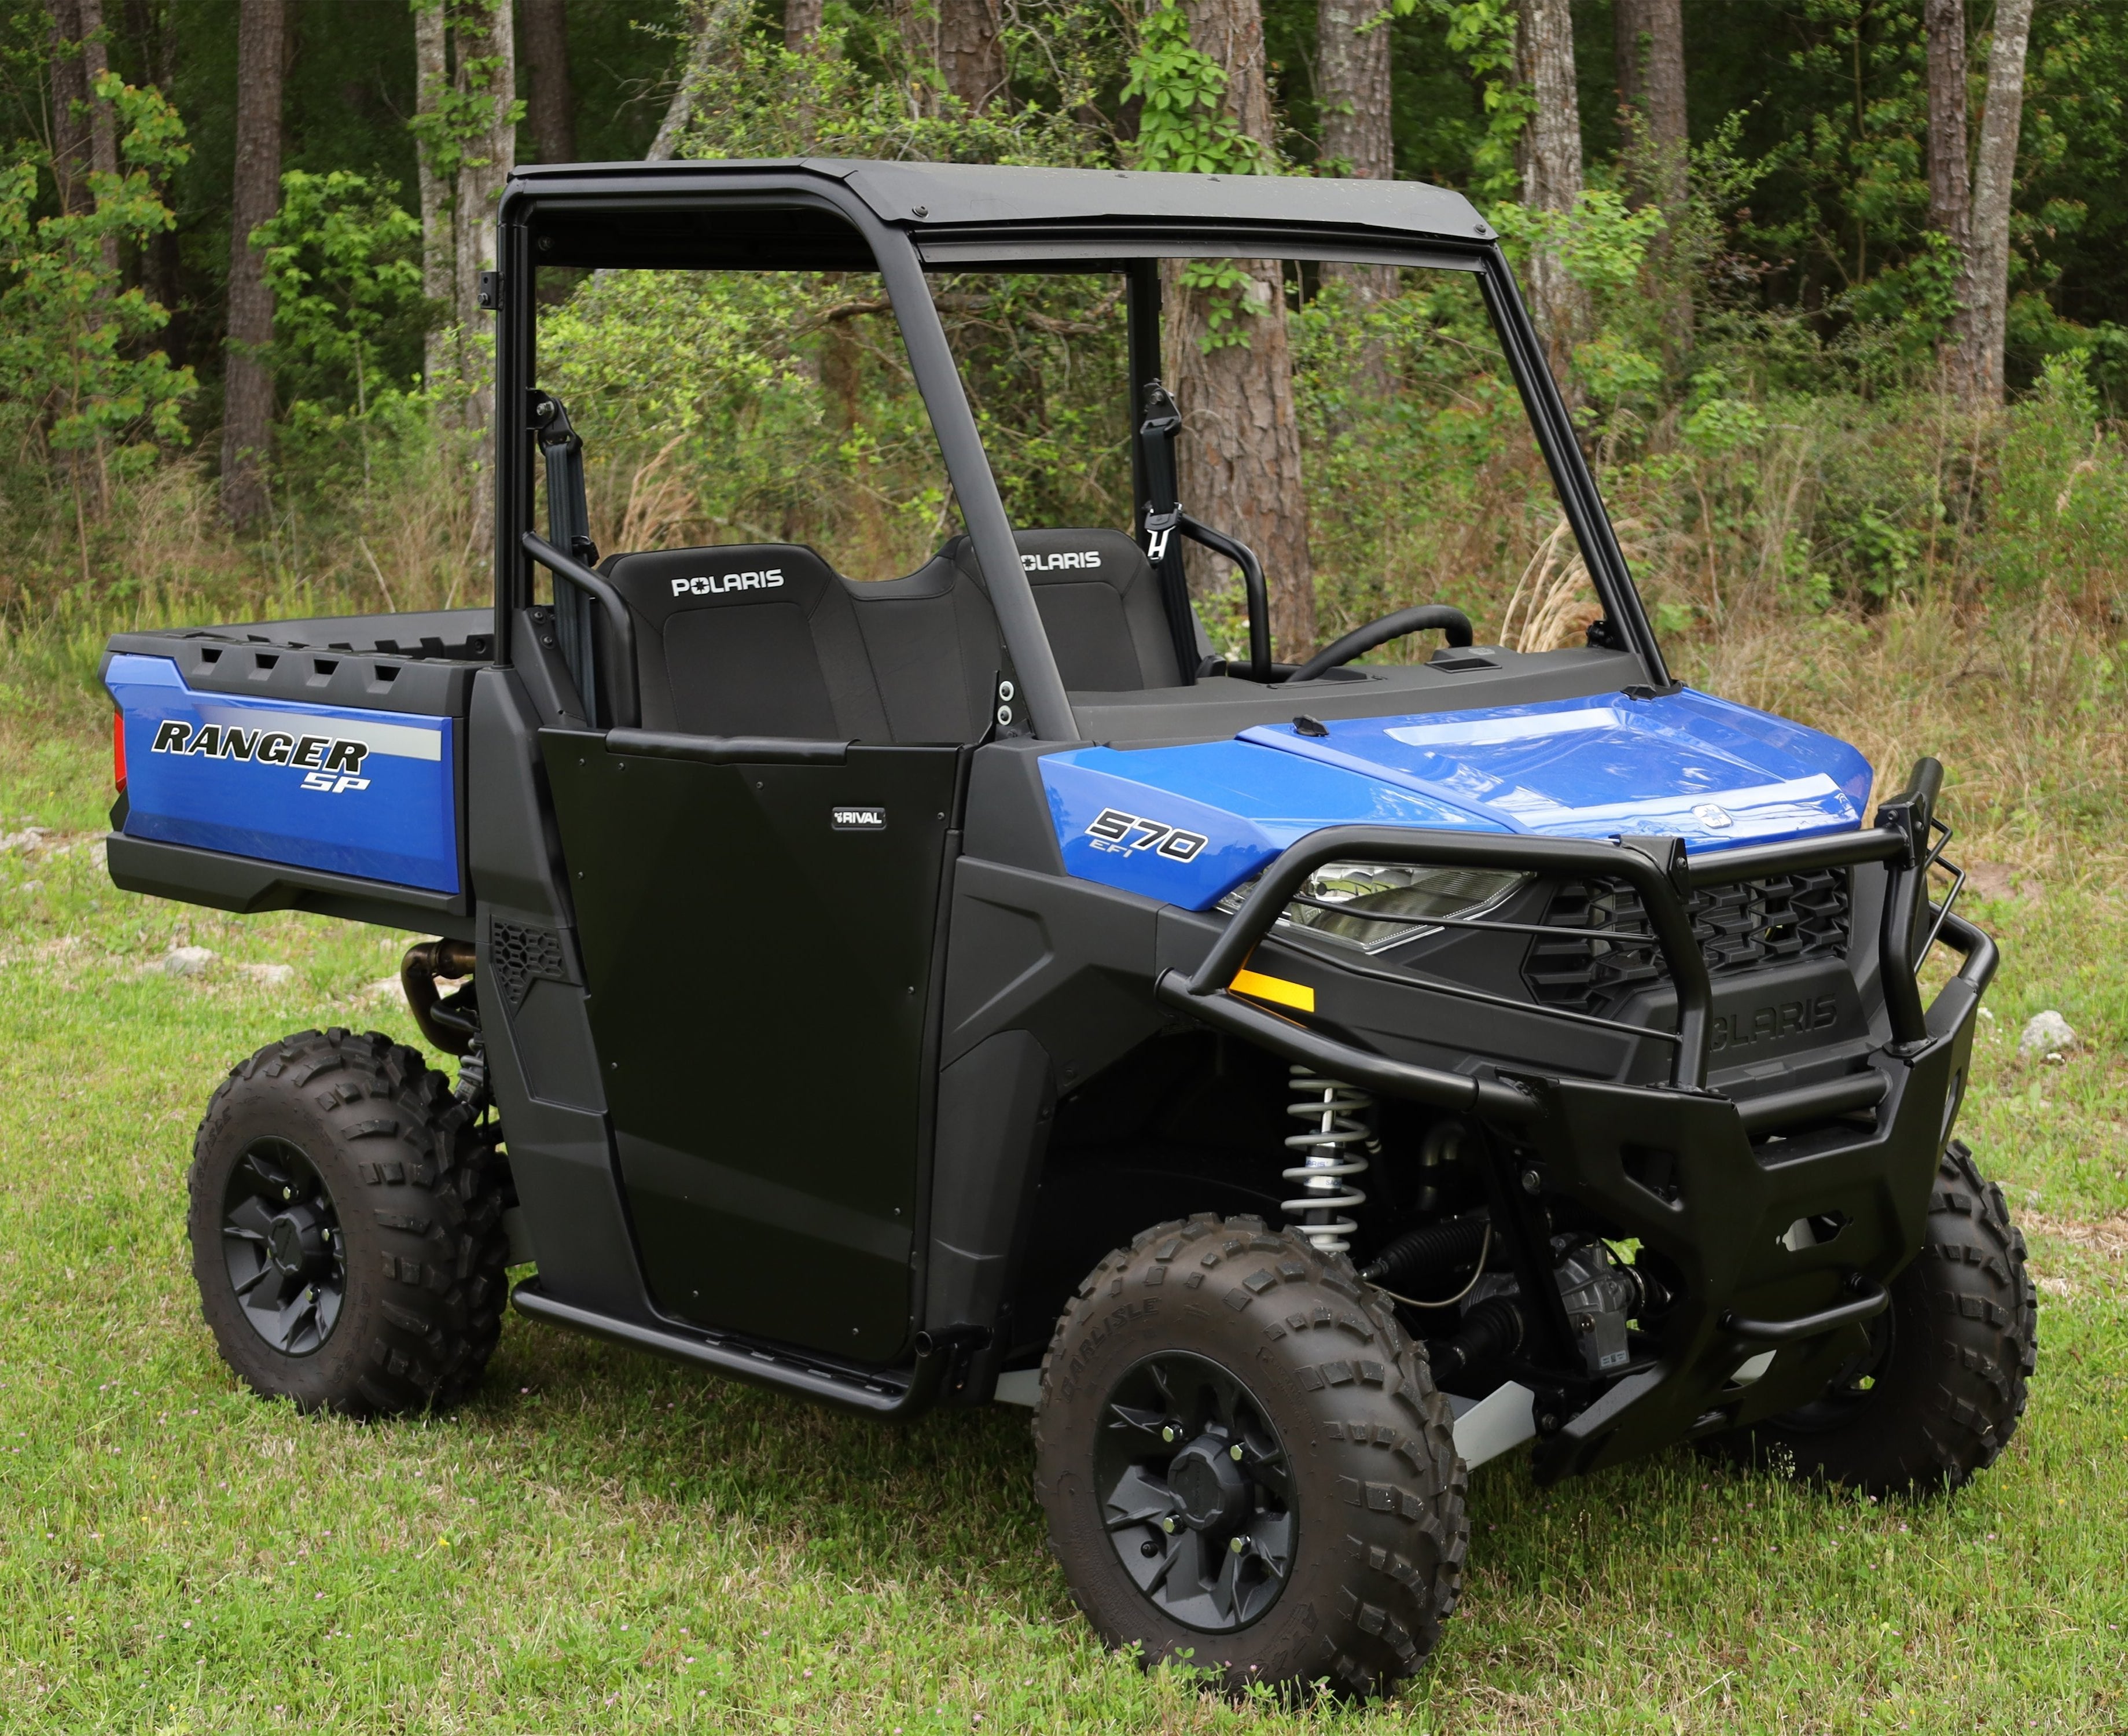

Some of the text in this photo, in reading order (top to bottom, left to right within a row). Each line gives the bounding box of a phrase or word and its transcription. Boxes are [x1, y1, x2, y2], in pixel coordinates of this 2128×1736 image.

[1020, 551, 1101, 571] OLARIS
[671, 569, 784, 597] POLARIS
[151, 720, 369, 775] RANGER
[300, 772, 371, 793] SP
[843, 812, 882, 823] RIVAL
[1084, 807, 1208, 863] 570
[1089, 838, 1133, 858] EFI
[1709, 993, 1837, 1053] OLARIS
